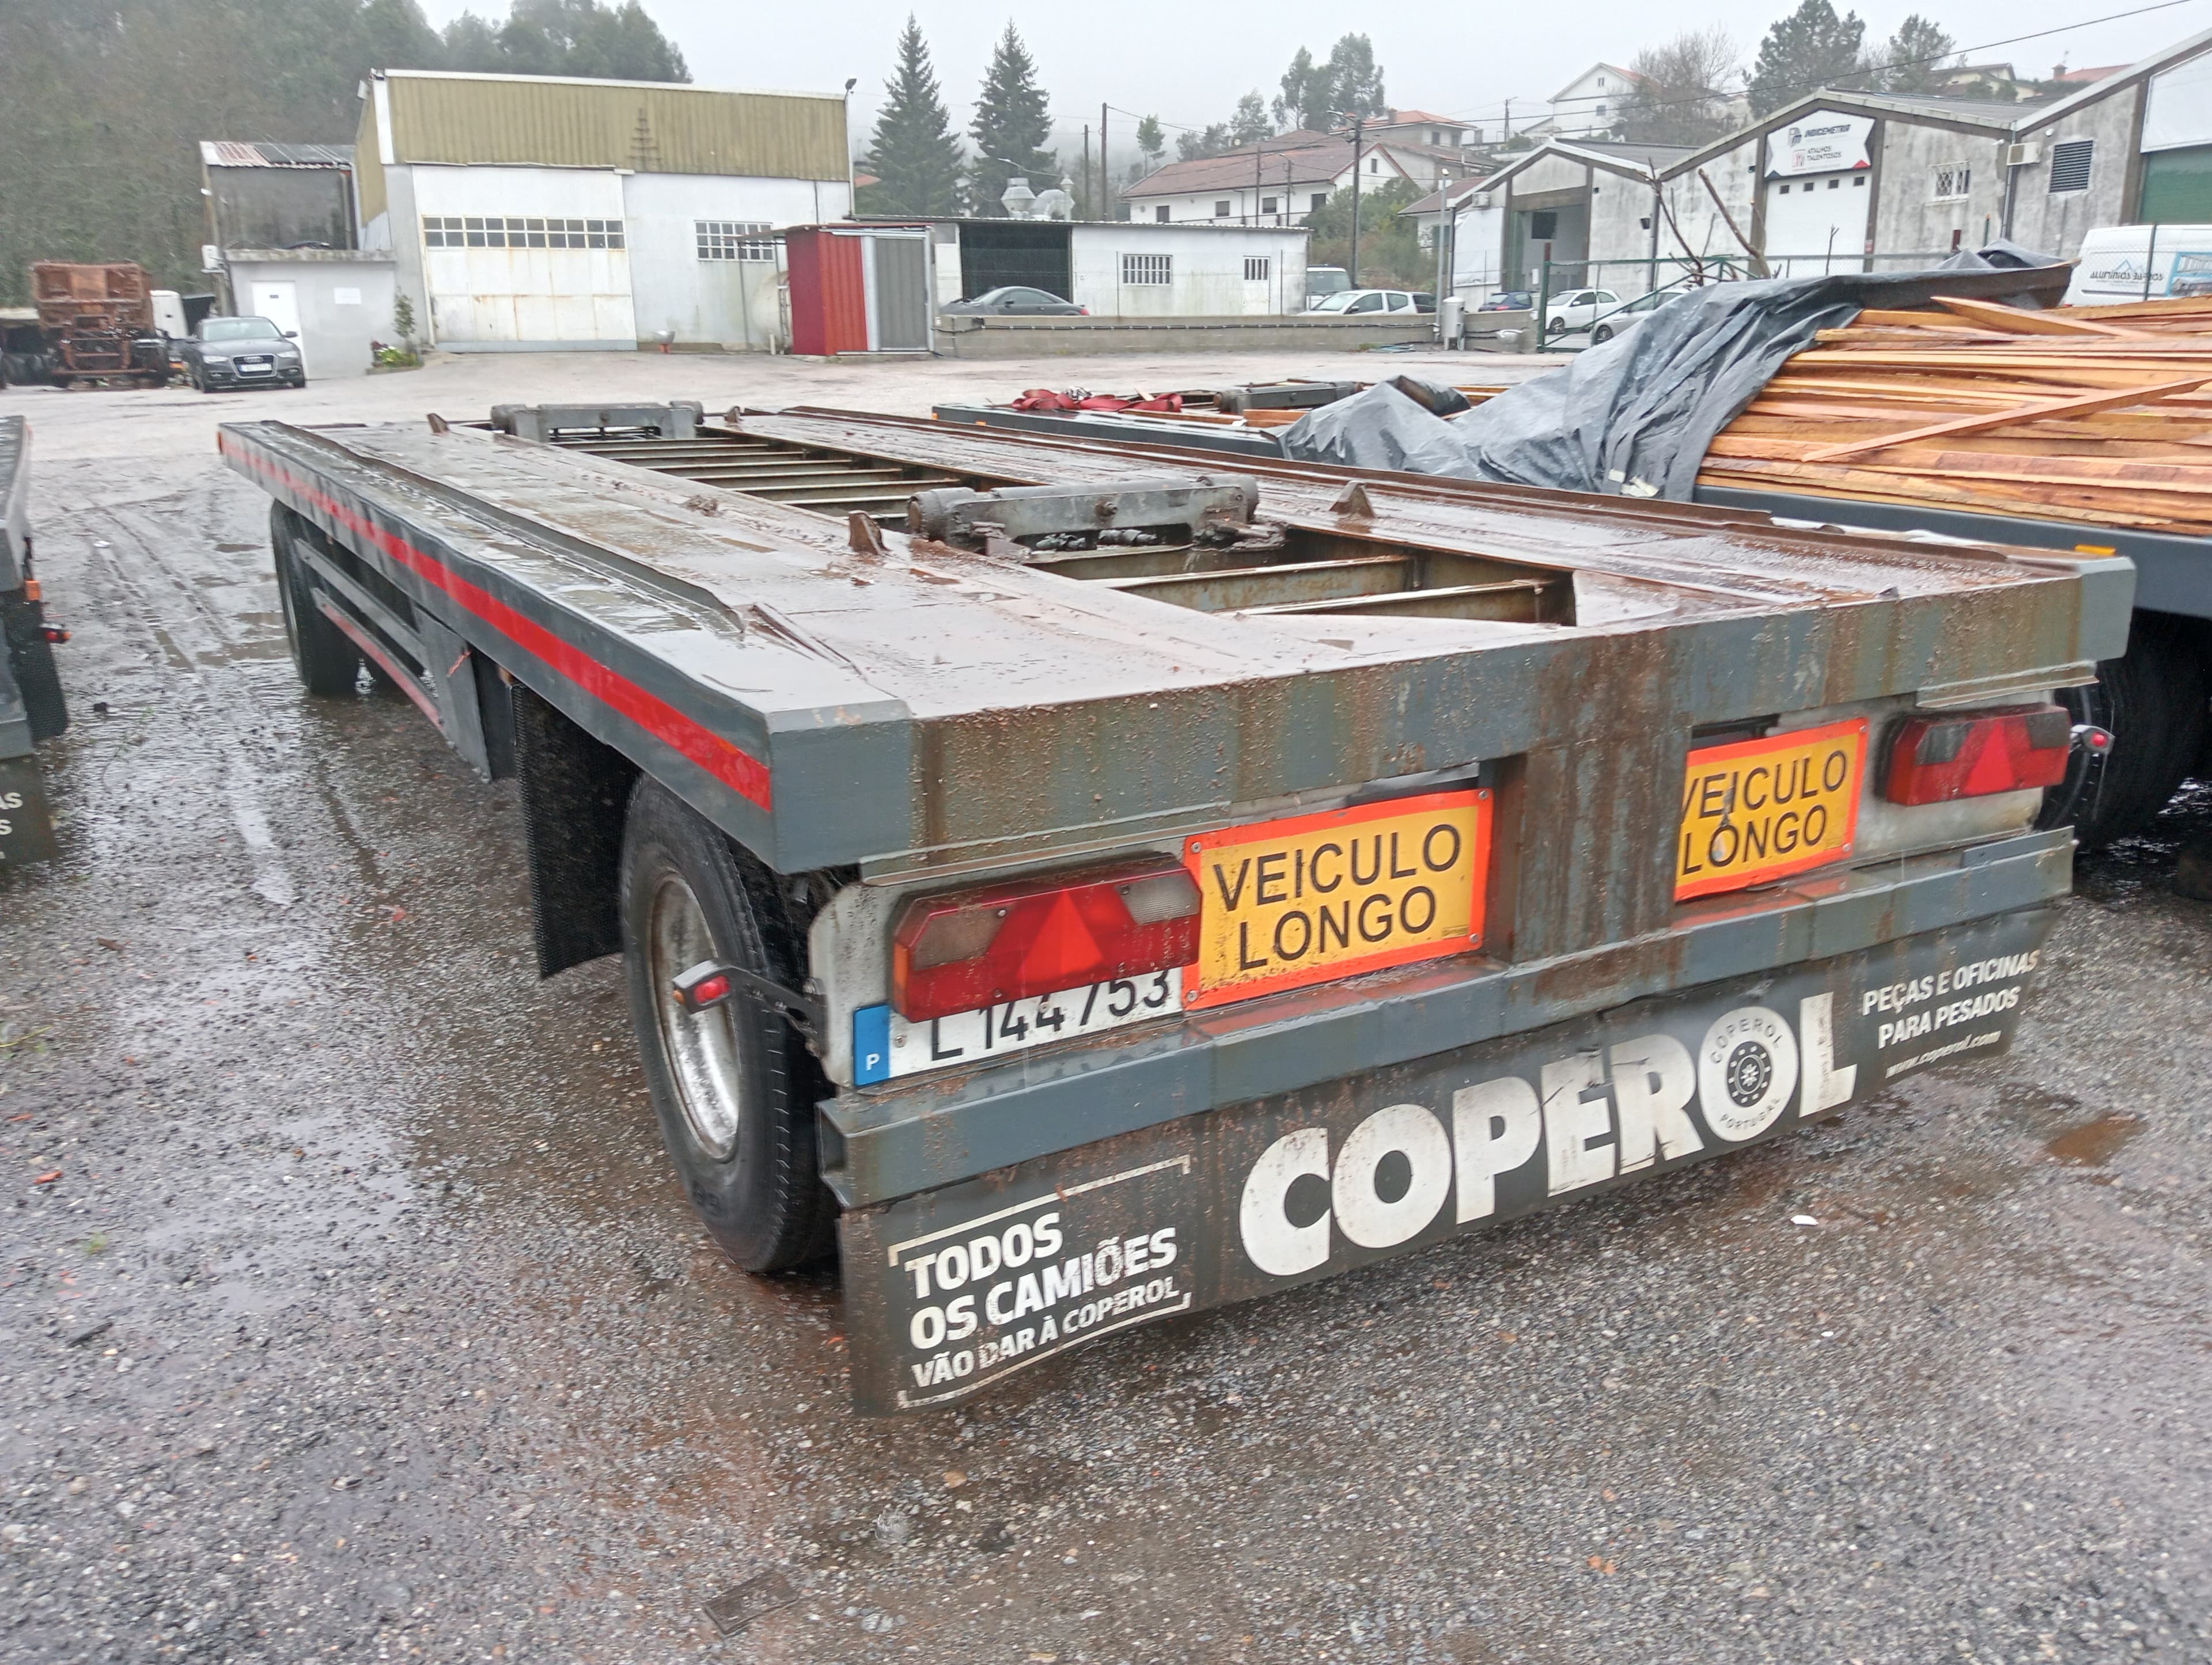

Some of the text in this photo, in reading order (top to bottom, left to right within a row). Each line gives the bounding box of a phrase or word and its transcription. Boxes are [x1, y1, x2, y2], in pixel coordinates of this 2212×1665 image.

[1213, 824, 1460, 912] VEICULO
[1682, 805, 1827, 876] LONGO
[1240, 886, 1436, 971] LONGO
[1862, 949, 2041, 1015] PEÇAS E OFICINAS
[1878, 985, 2021, 1049] PARA PESADOS
[865, 1053, 881, 1072] P
[1710, 1018, 1782, 1064] COPEROL
[1239, 991, 1857, 1276] COPEROL
[904, 1212, 1063, 1299] TODOS
[910, 1227, 1178, 1350] OS CAMIÕES
[911, 1348, 974, 1388] VÃO
[979, 1327, 1036, 1370] DAR
[1062, 1276, 1180, 1335] COPEROL
